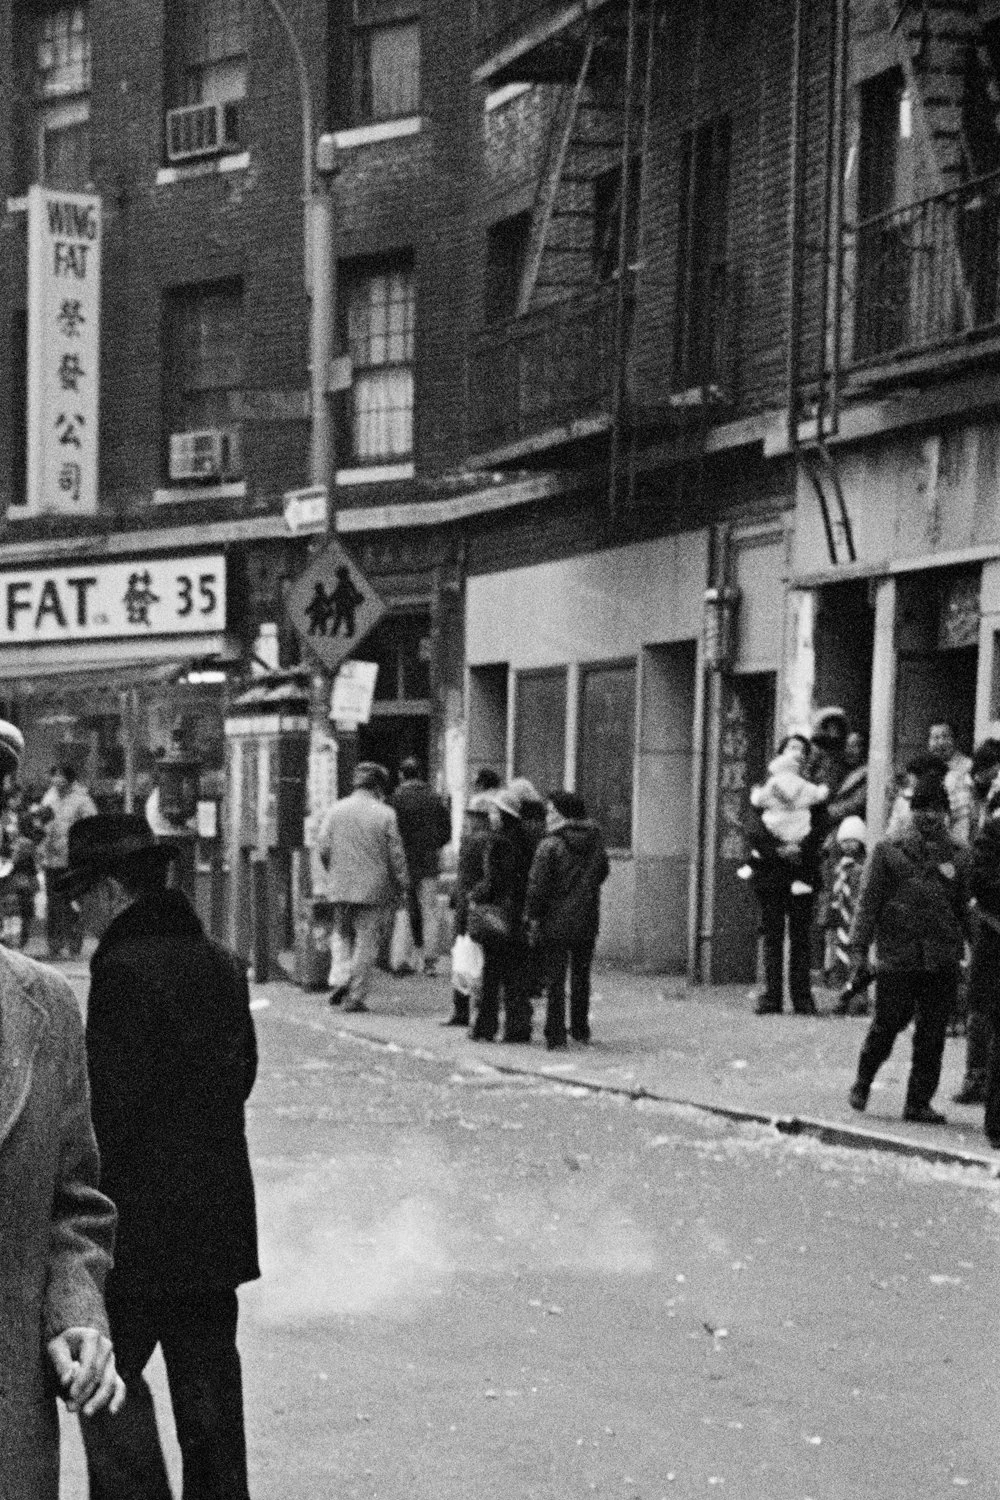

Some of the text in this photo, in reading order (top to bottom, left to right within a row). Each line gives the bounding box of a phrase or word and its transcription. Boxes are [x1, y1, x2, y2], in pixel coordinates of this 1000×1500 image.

[49, 200, 97, 240] WING
[54, 242, 90, 279] FAT
[6, 576, 97, 631] FAT
[175, 573, 218, 617] 35
